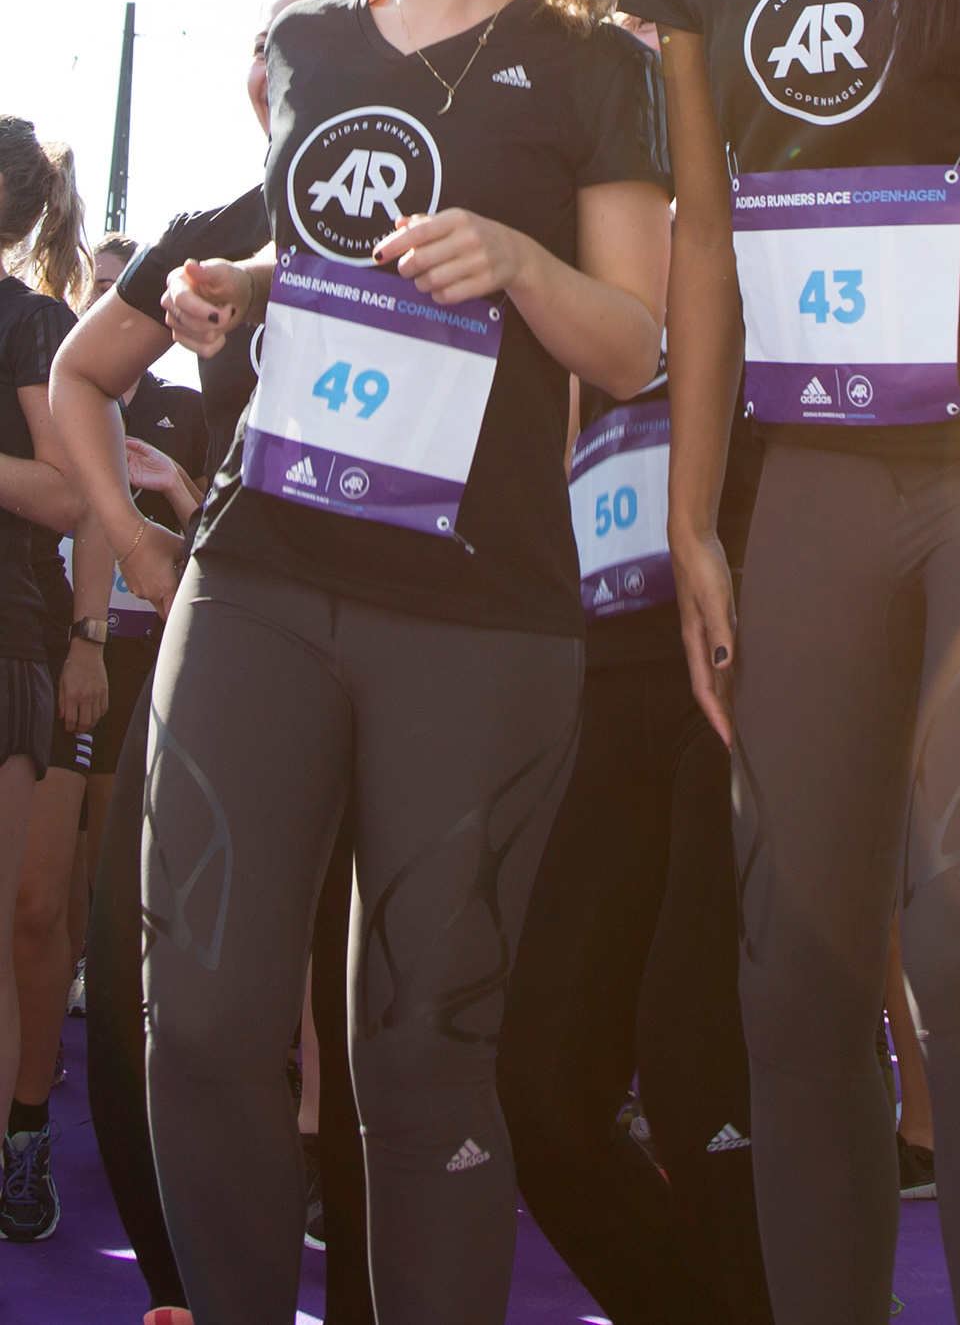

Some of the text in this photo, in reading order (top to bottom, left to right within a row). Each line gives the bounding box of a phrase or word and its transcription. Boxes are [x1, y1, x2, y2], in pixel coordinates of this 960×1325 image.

[767, 1, 869, 79] AR
[784, 78, 864, 107] COPENHAGEN
[322, 121, 420, 159] ADIDAS RUNNERS
[307, 148, 408, 222] AR
[735, 189, 946, 210] ADIDAS RUNNERS RACE COPENHAGEN
[279, 270, 489, 336] ADIDAS RUNNERS RACE COPENHAGEN
[798, 269, 867, 324] 43
[312, 360, 390, 420] 49
[800, 393, 833, 405] adidas
[595, 486, 638, 540] 50
[446, 1149, 490, 1173] adidas
[706, 1136, 751, 1153] adidas
